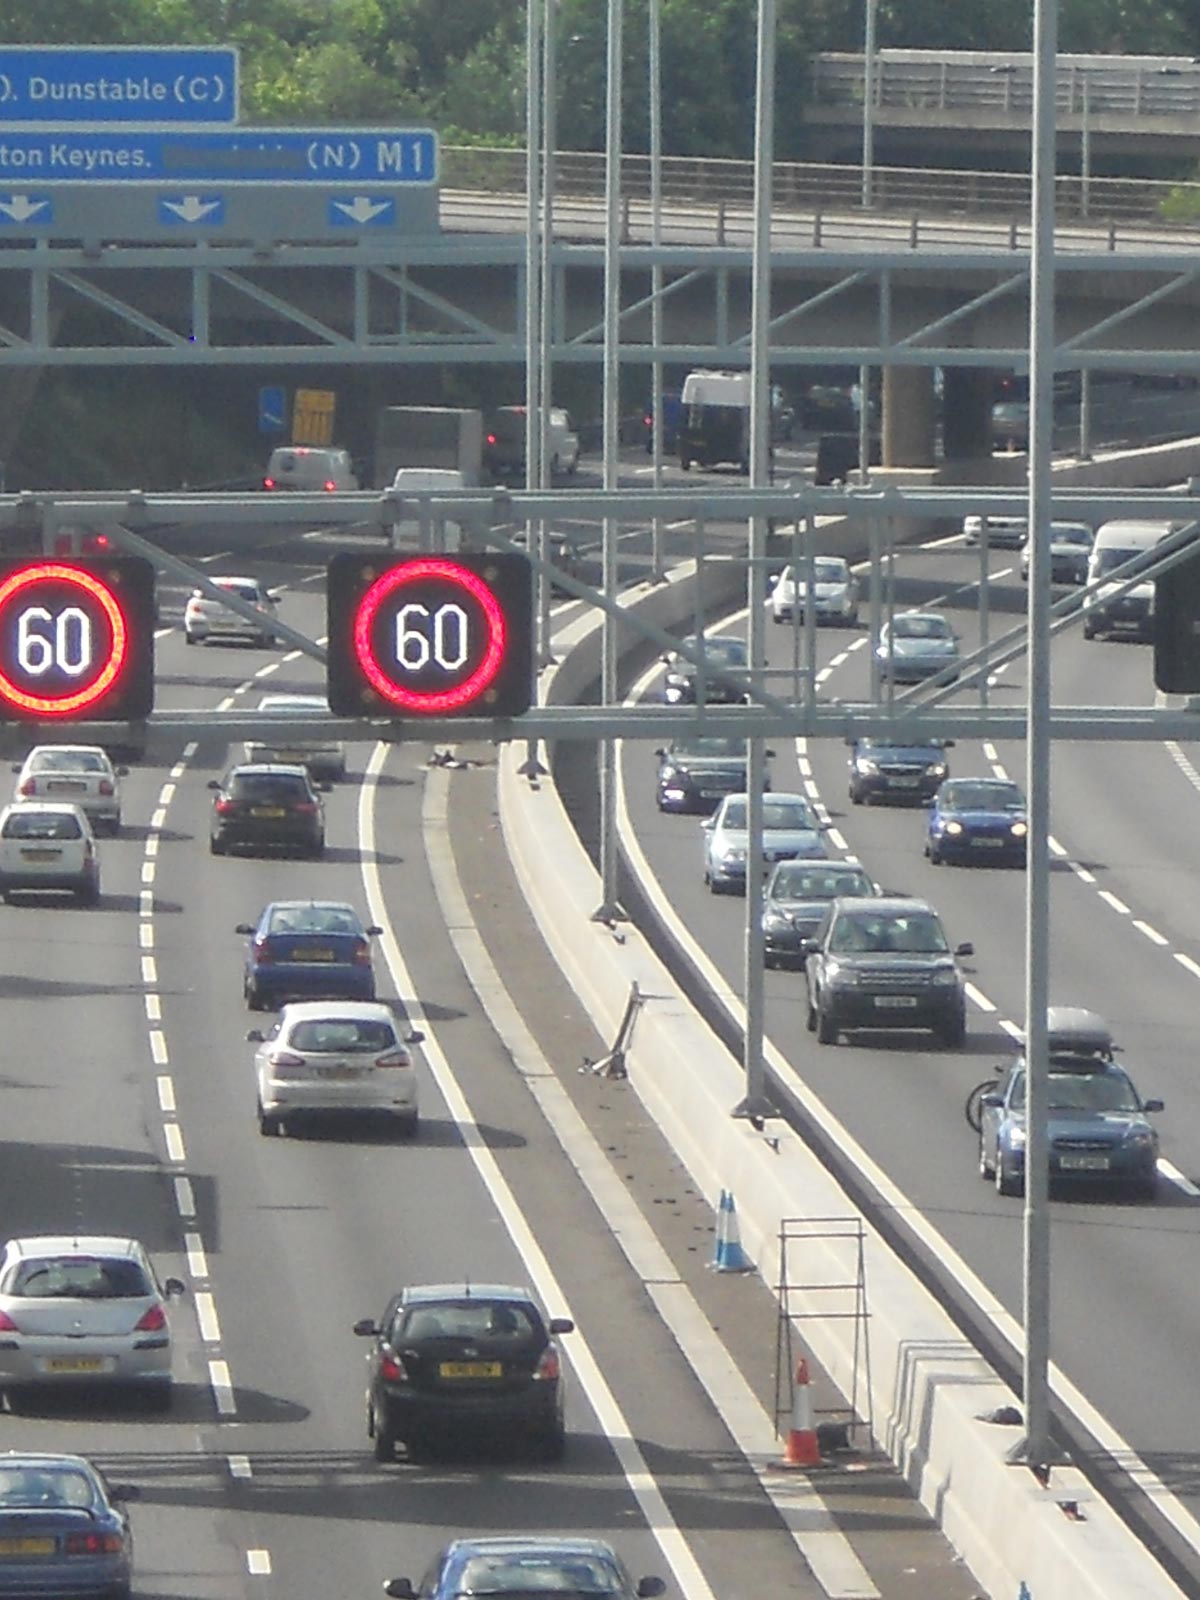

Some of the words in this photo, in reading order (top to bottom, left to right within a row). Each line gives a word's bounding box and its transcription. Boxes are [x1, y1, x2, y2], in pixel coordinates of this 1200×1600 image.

[30, 77, 166, 100] Dunstable
[174, 75, 224, 102] (C)
[308, 141, 360, 170] (N)
[16, 606, 93, 677] 60
[395, 602, 469, 672] 60
